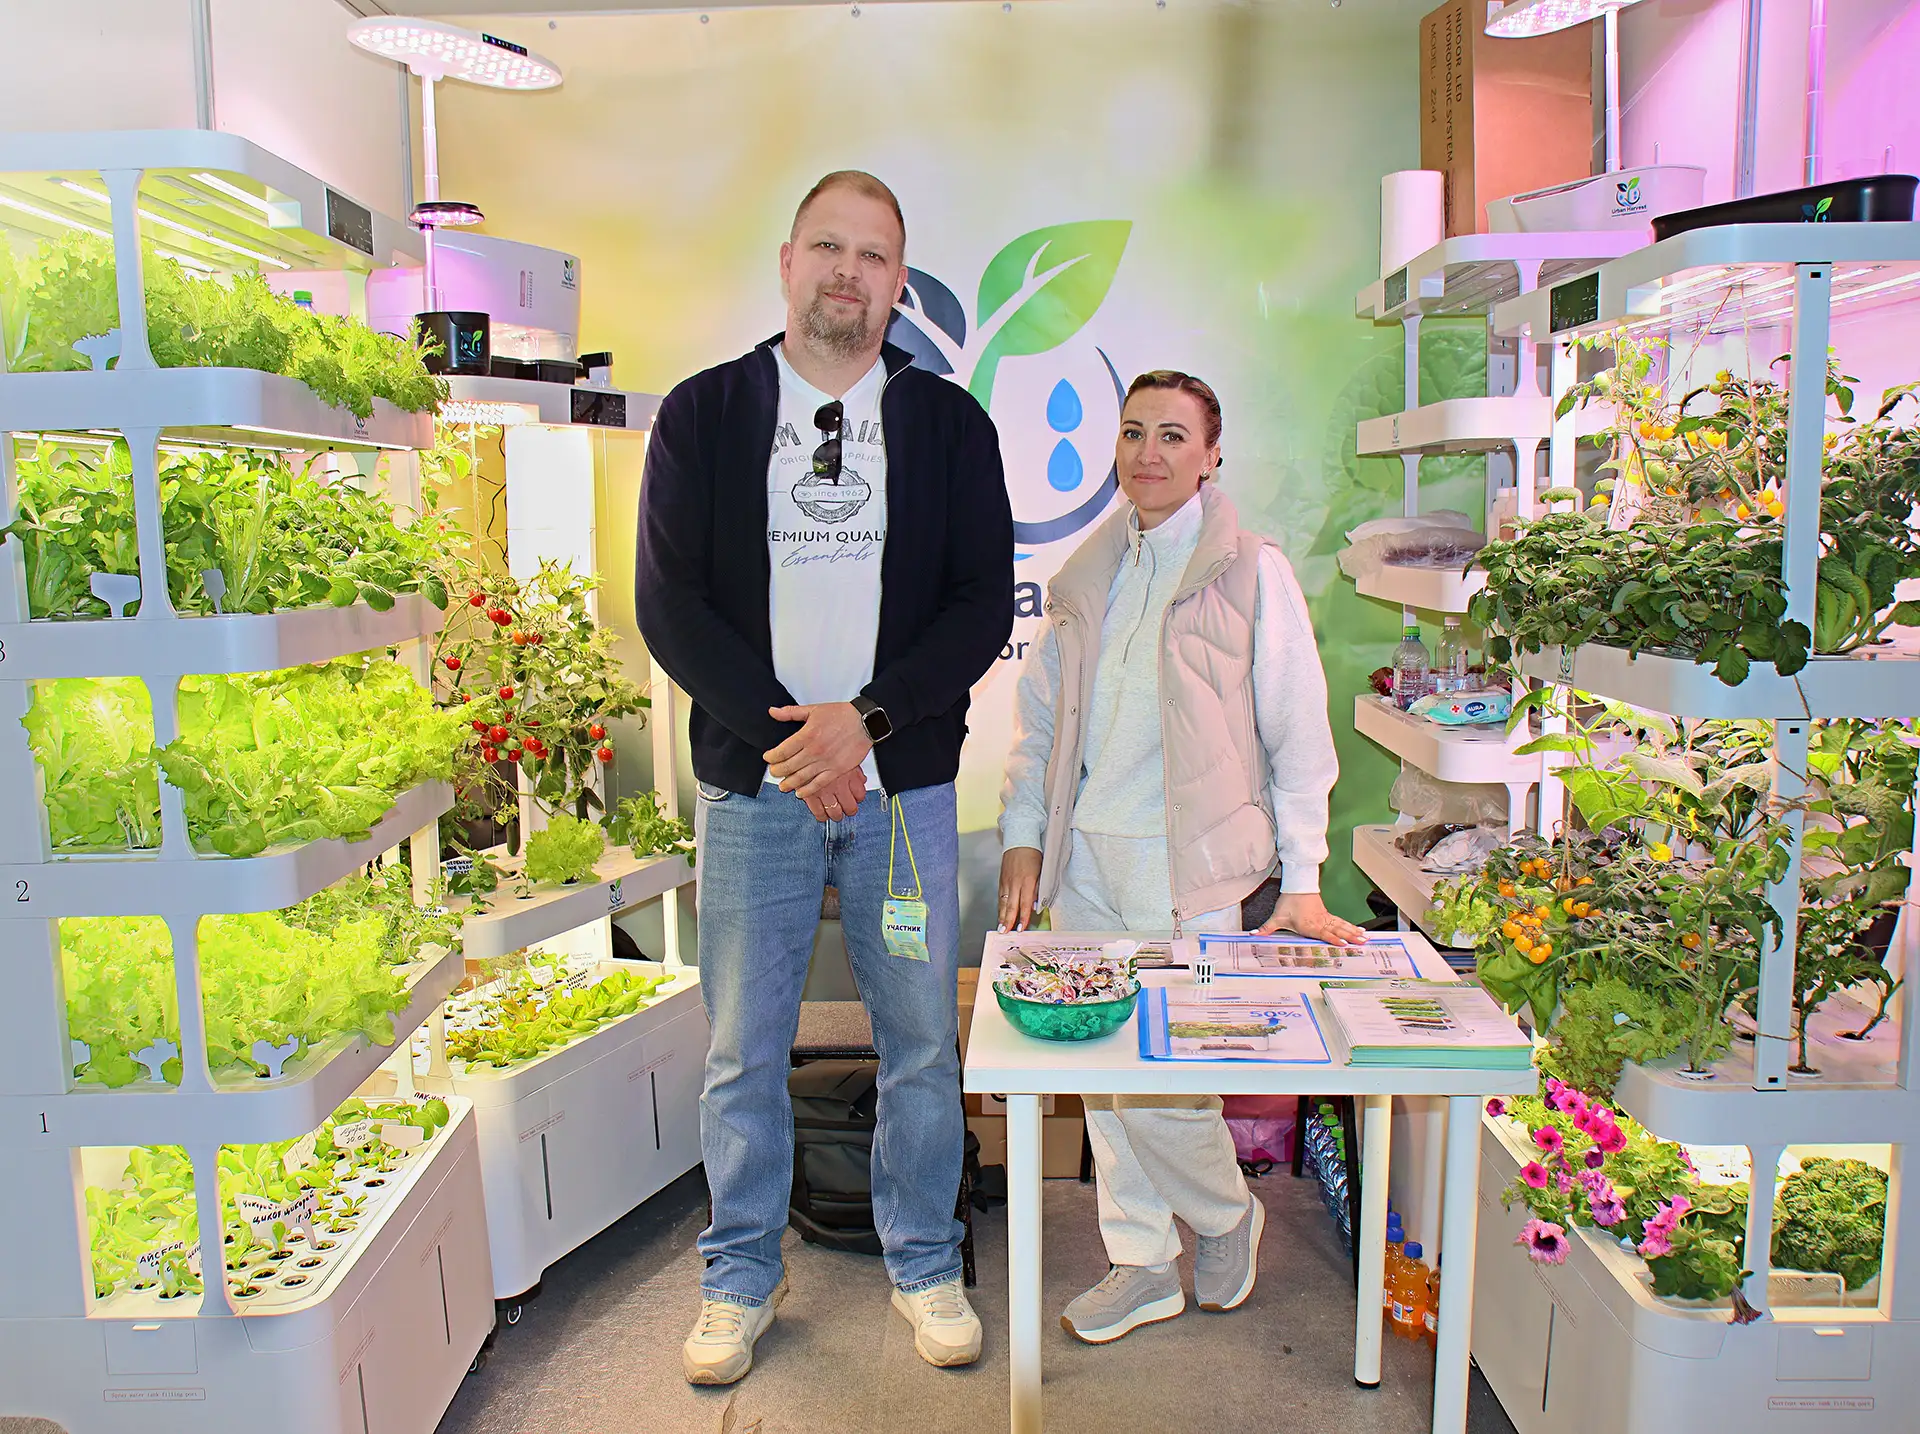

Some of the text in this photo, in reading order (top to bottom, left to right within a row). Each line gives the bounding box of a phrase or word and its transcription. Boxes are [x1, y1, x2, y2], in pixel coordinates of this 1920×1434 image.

[814, 488, 865, 498] since 1962
[781, 541, 875, 568] Essentials
[1014, 581, 1043, 618] a
[1467, 704, 1485, 713] AURA
[15, 879, 30, 902] 2
[886, 924, 921, 933] УЧАСТНИК
[1249, 1010, 1302, 1018] 50%
[38, 1112, 51, 1134] 1
